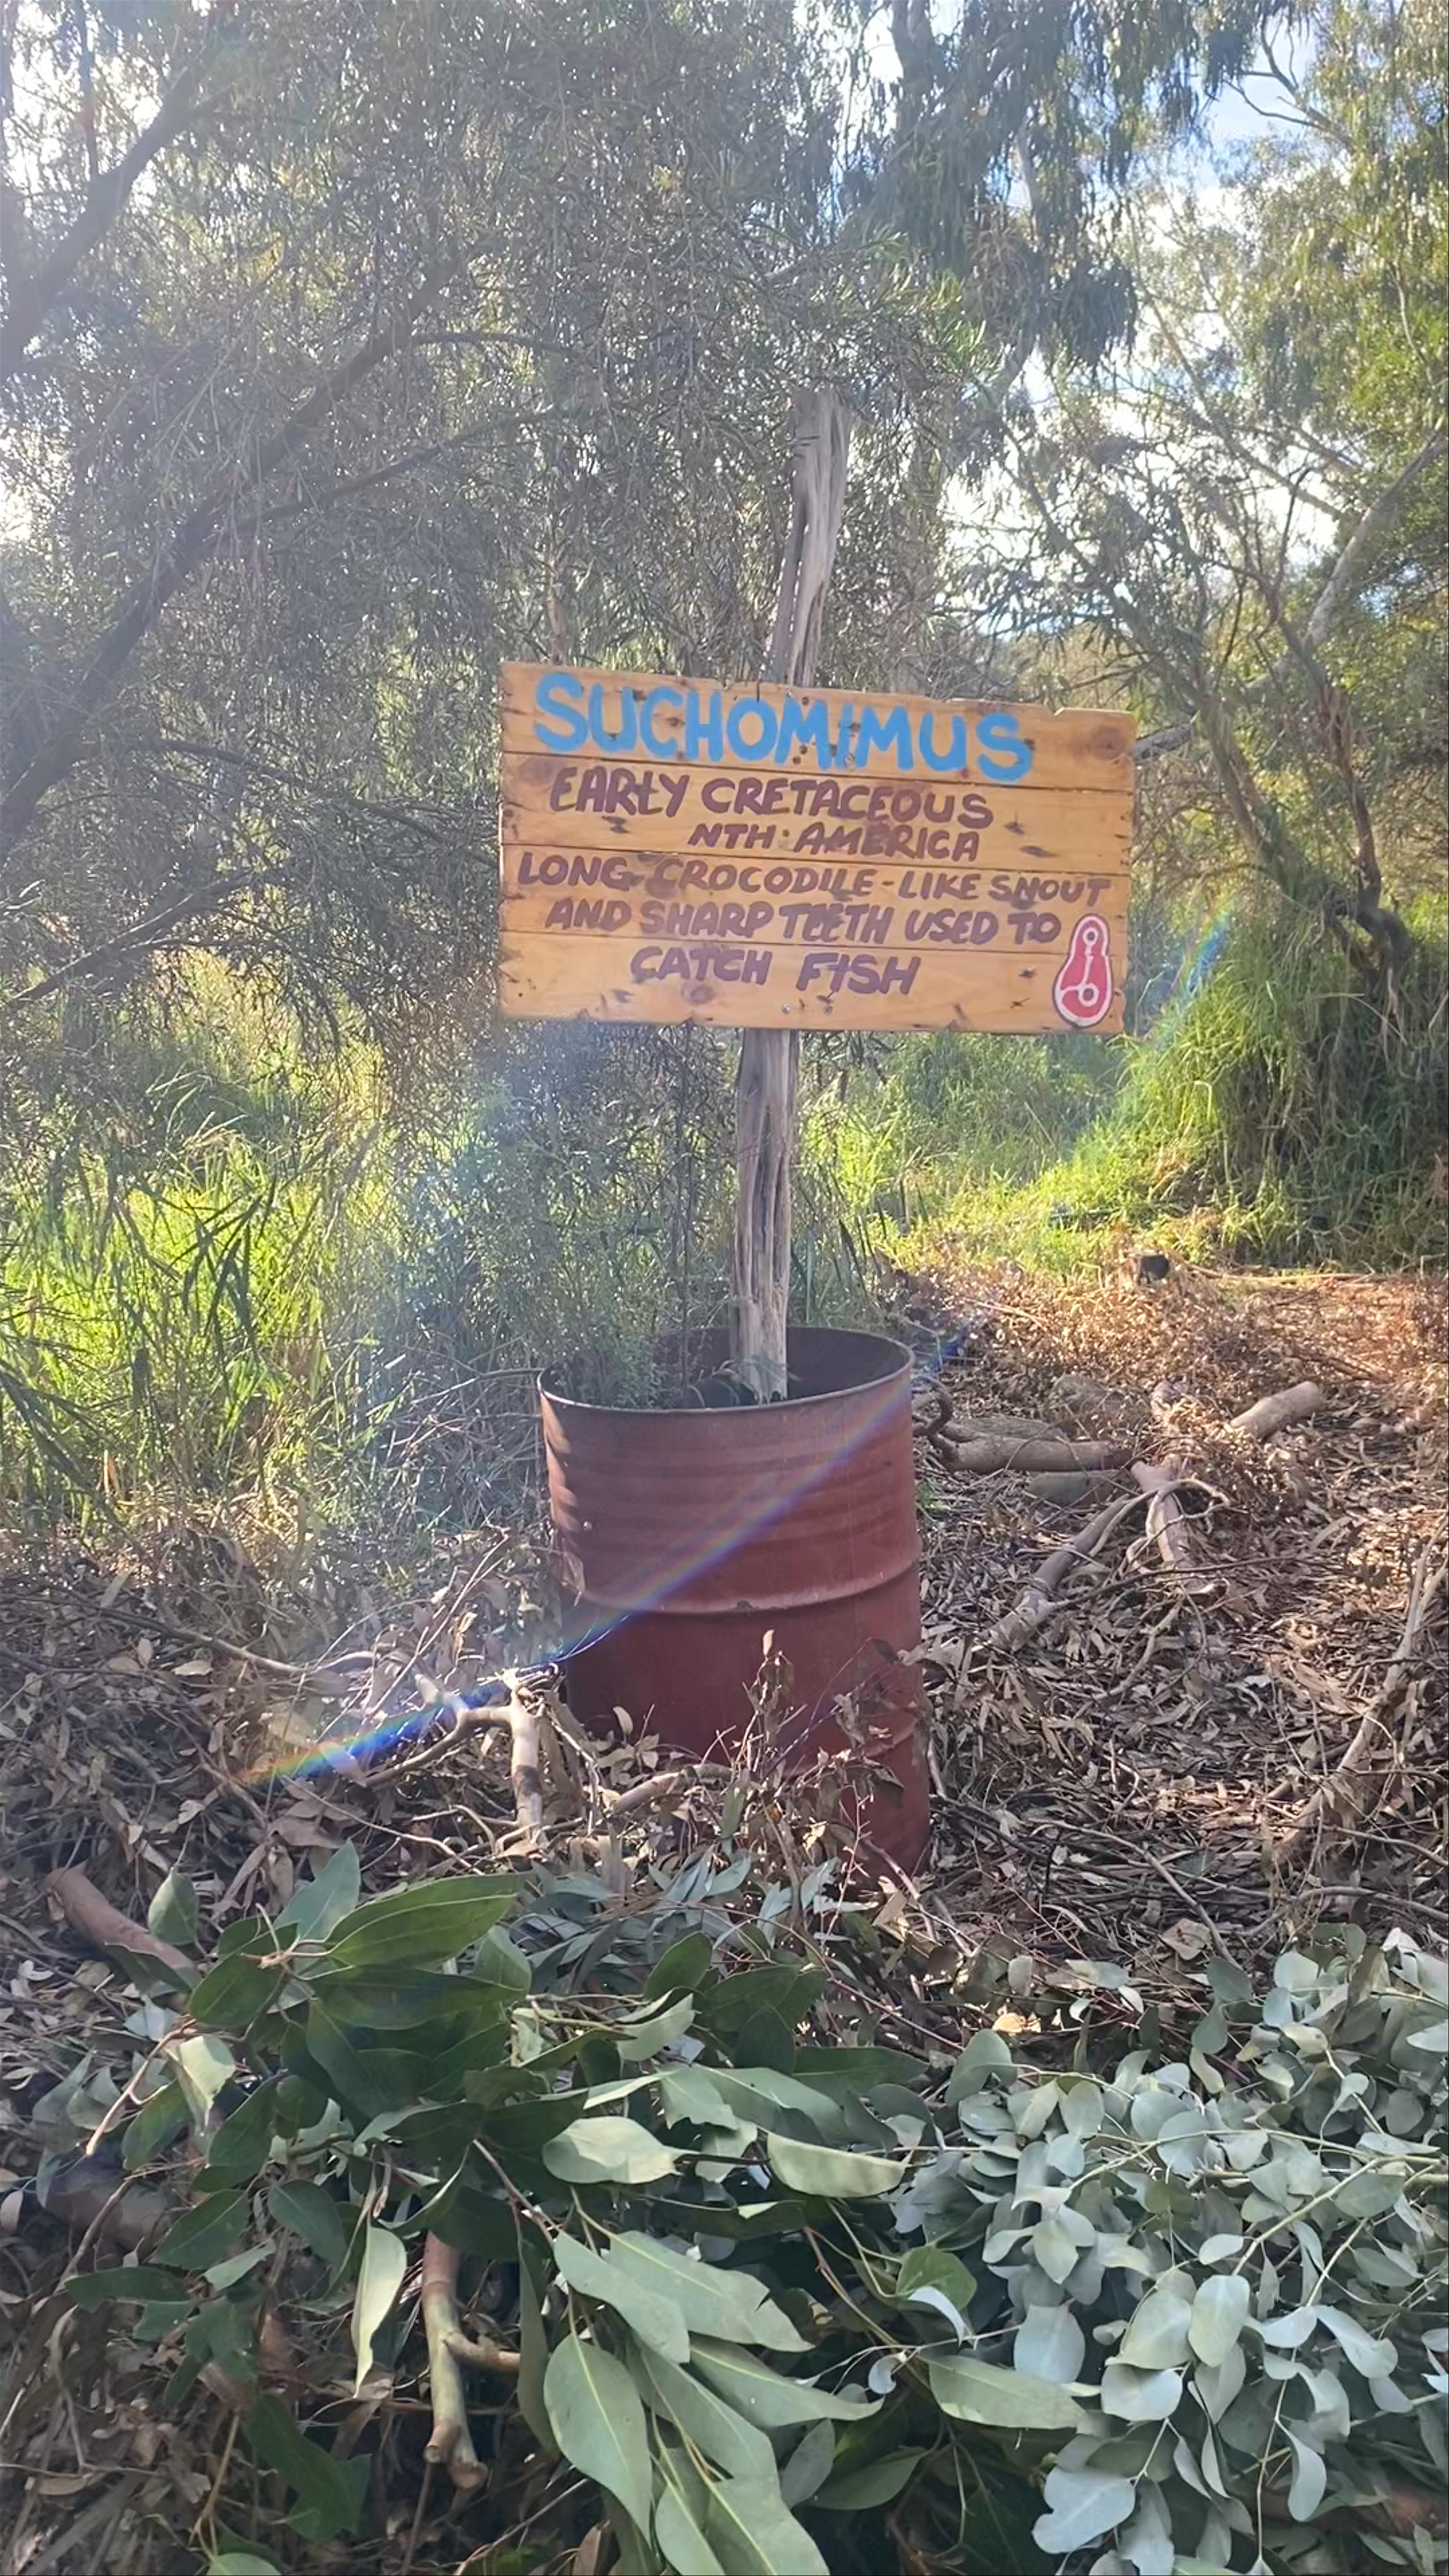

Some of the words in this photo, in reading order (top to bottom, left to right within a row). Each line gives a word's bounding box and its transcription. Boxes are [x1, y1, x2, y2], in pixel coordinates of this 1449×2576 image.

[534, 672, 1033, 784] SUCHOMIMUS
[549, 766, 690, 818] EARLY
[701, 777, 994, 830] CRETACEOUS
[794, 821, 980, 862] AMERICA
[988, 874, 1111, 906] SNOUT
[545, 897, 632, 932] AND
[639, 900, 774, 938] SHARP
[779, 902, 895, 944] TEETH
[905, 908, 999, 945] USED
[1007, 912, 1062, 945] TO
[630, 945, 773, 986] CATCH
[795, 952, 922, 994] FISH
